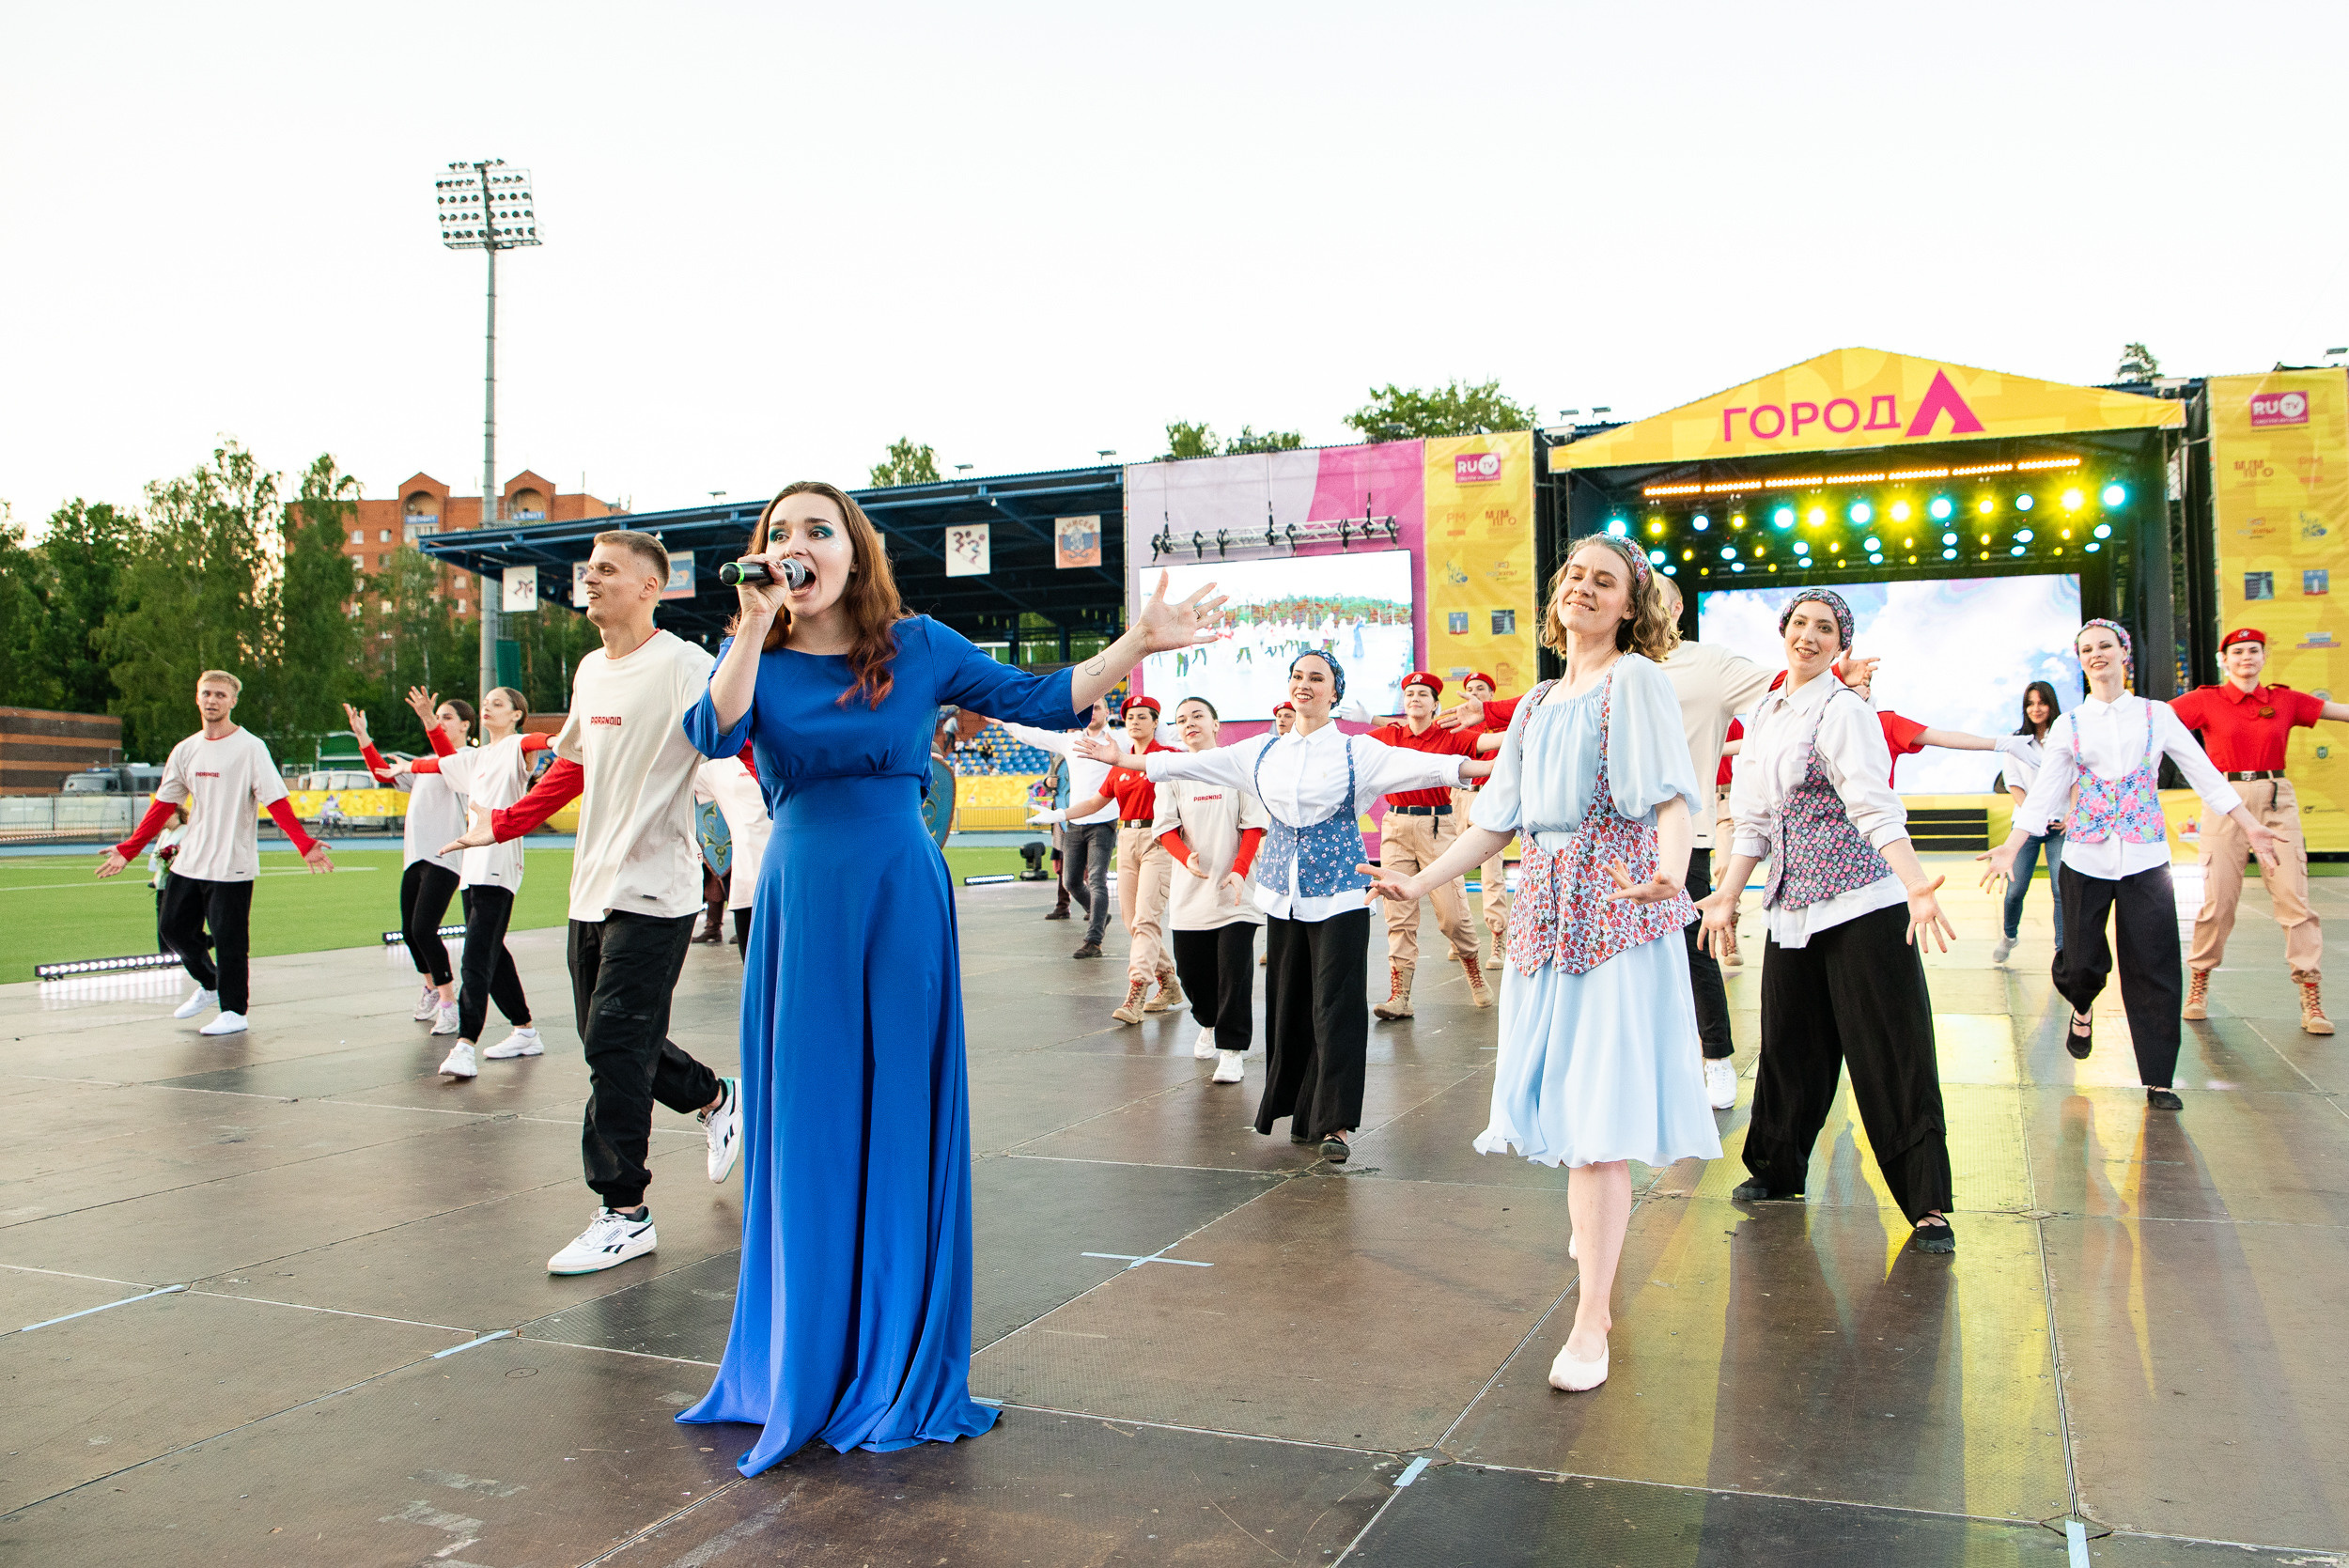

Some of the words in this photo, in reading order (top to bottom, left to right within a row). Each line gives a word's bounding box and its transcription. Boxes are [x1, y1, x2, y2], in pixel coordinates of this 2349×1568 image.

[2252, 400, 2279, 416] RU
[1722, 394, 1902, 442] ГОРОД
[1456, 460, 1478, 474] RU
[590, 716, 622, 726] PARANOID
[1193, 793, 1222, 802] PARANOID
